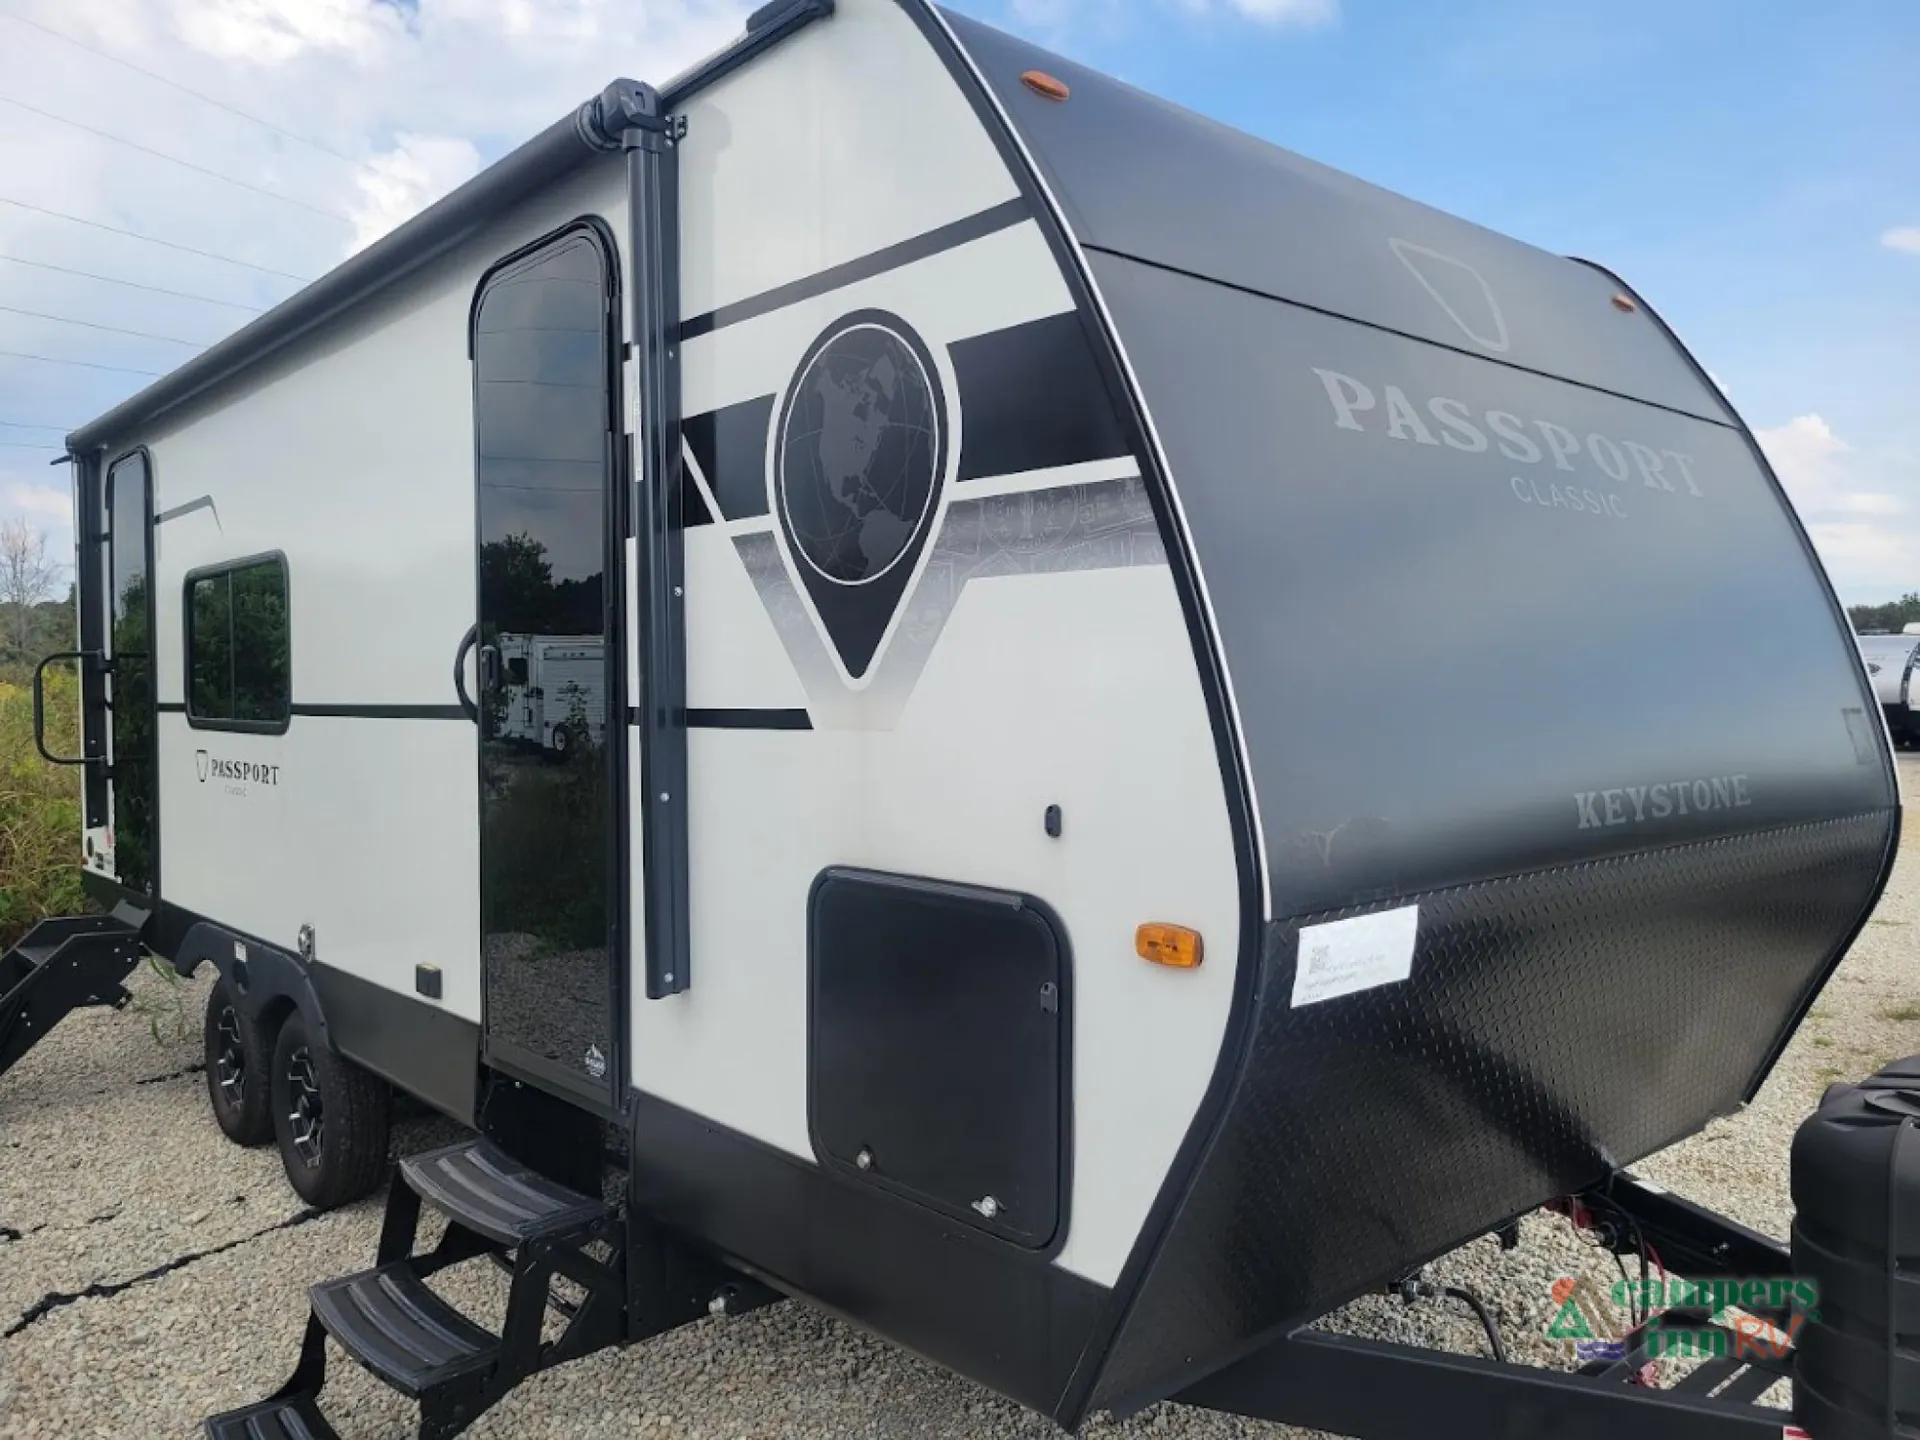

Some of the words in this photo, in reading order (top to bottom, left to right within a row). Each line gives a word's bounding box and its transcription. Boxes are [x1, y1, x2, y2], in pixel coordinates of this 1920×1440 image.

[1312, 367, 1703, 498] PASSPORT
[1510, 477, 1628, 519] CLASSIC
[211, 759, 279, 785] PASSPORT
[1574, 774, 1752, 829] KEYSTONE
